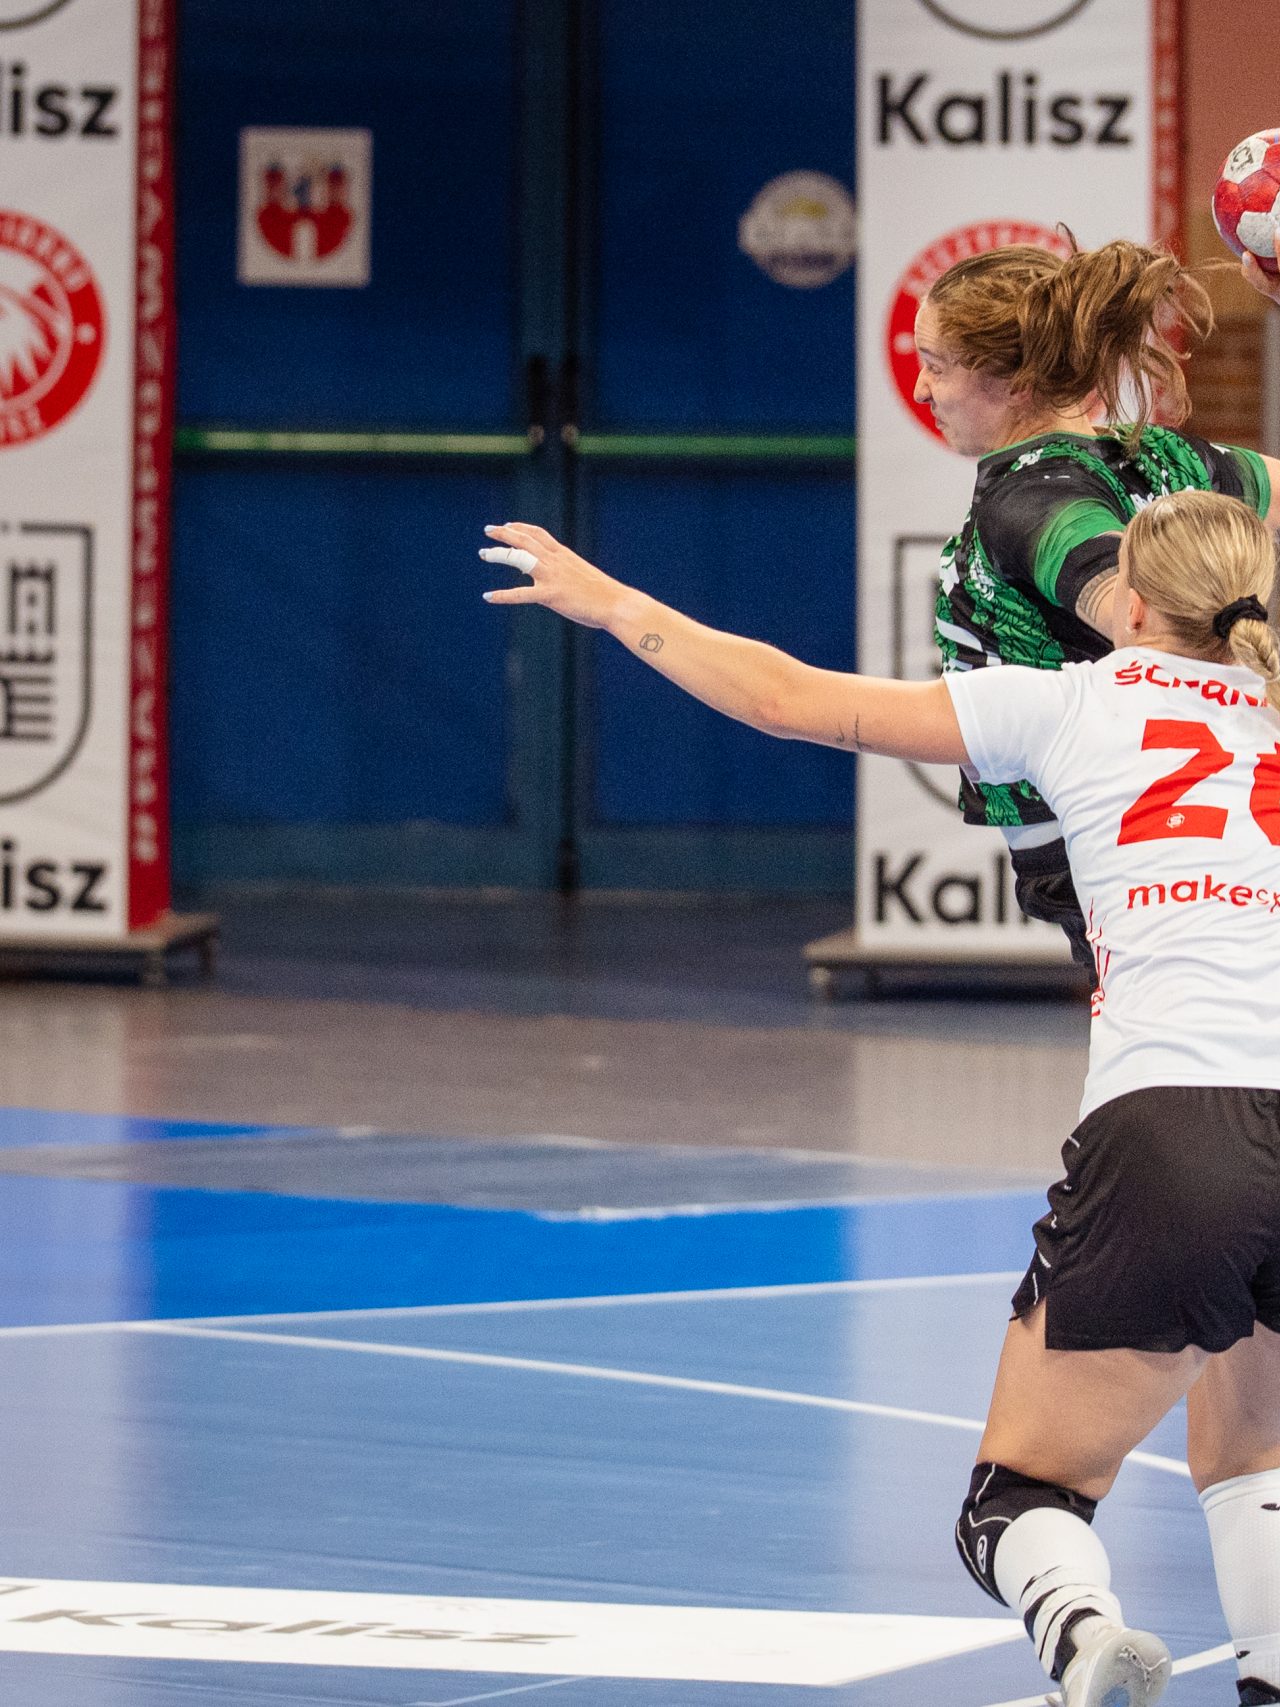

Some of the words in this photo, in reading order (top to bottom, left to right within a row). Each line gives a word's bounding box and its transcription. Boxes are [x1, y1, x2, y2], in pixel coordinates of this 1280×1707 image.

[0, 61, 117, 139] isz
[876, 69, 1132, 146] Kalisz
[8, 1608, 577, 1646] Kalisz
